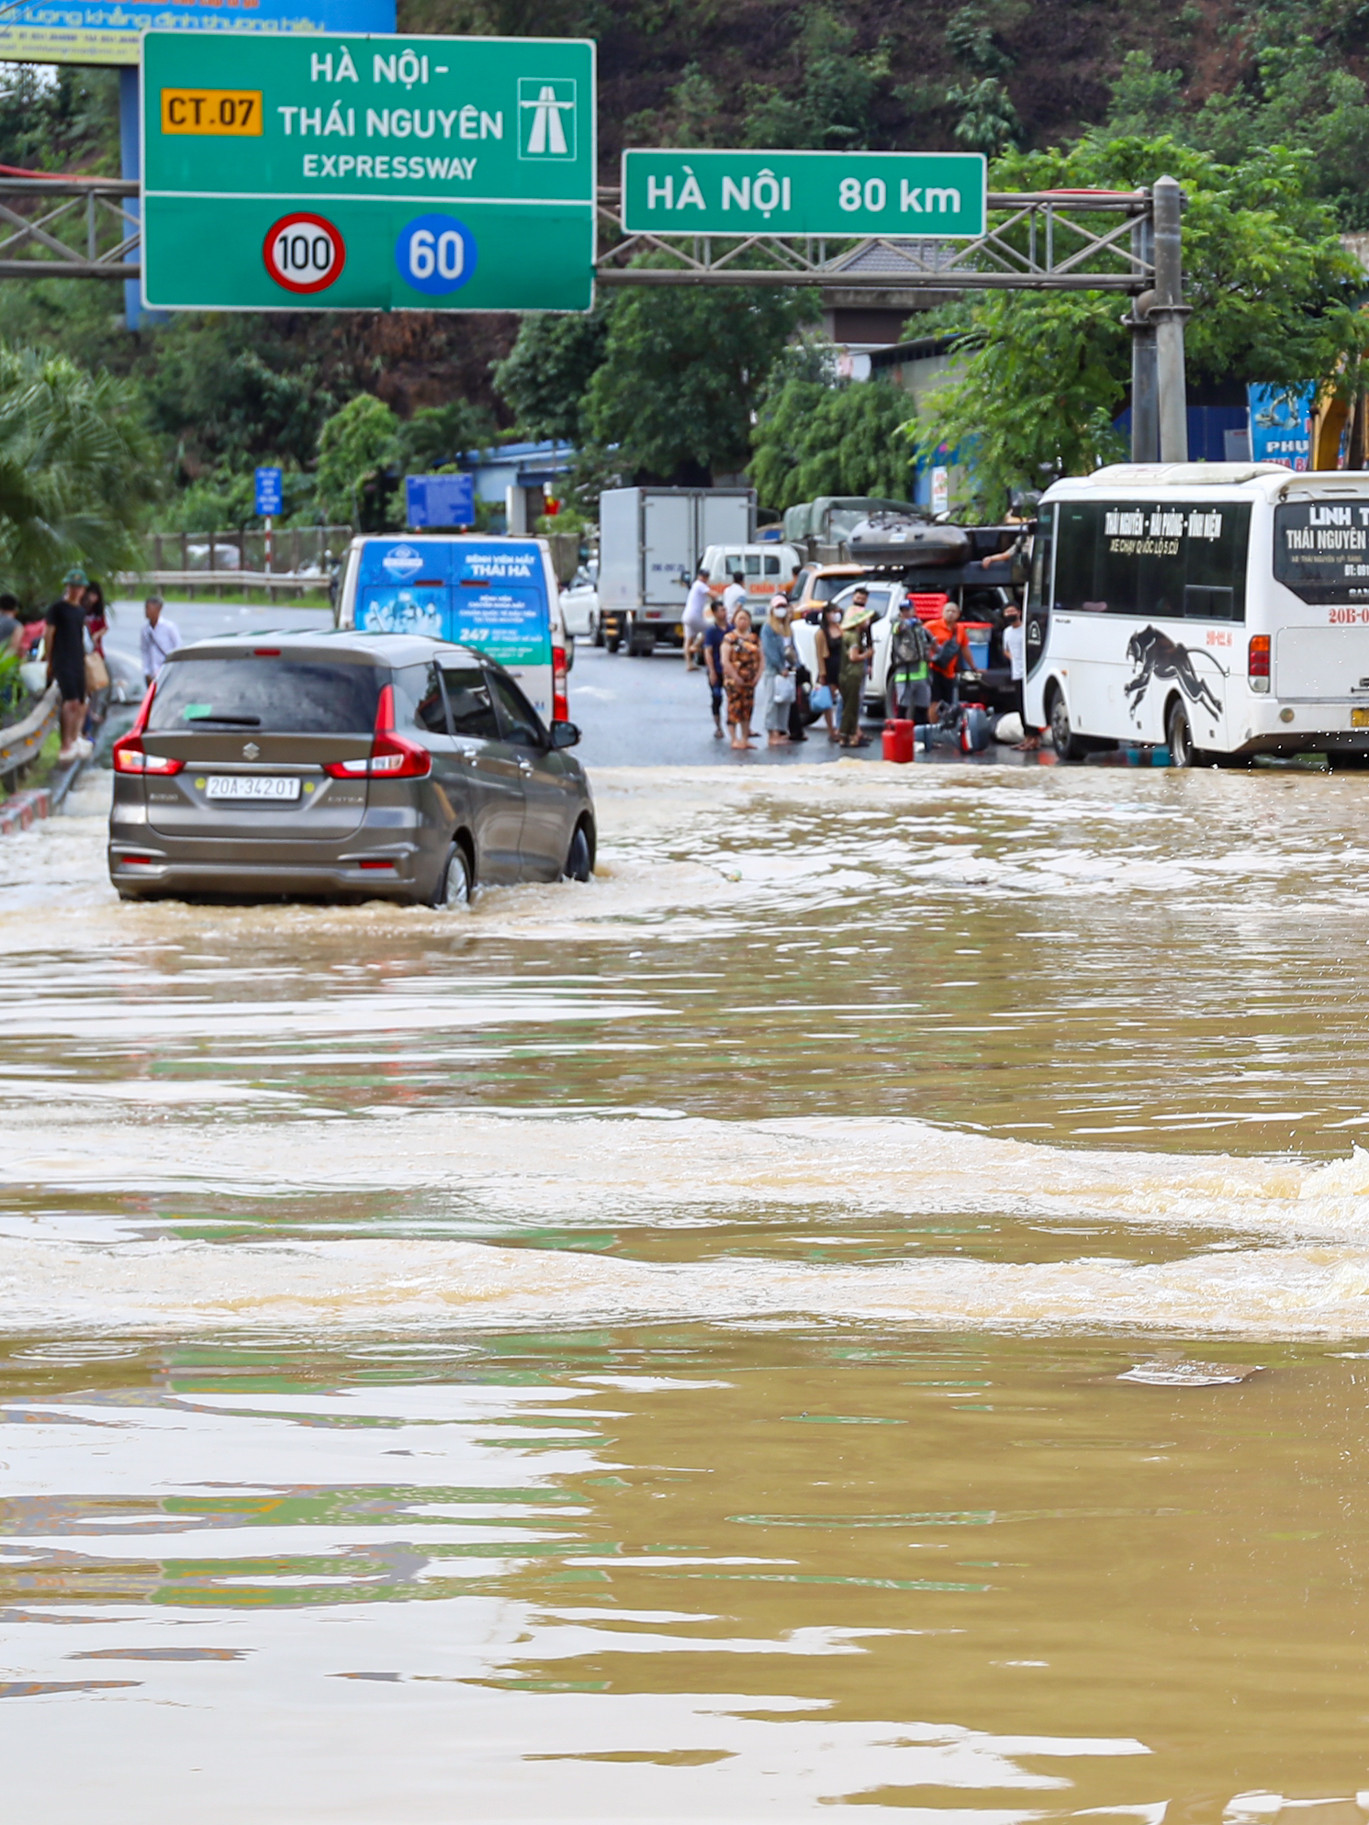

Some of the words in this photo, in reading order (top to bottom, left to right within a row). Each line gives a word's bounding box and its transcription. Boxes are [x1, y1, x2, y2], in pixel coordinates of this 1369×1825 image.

[310, 45, 359, 83] HÀ
[168, 97, 255, 127] CT.07
[277, 98, 356, 137] THÁI
[366, 104, 504, 140] NGUYÊN
[302, 153, 478, 180] EXPRESSWAY
[646, 165, 707, 210] HÀ
[721, 167, 792, 219] NỘI
[838, 177, 888, 213] 80
[900, 178, 961, 213] km
[278, 235, 331, 270] 100
[409, 229, 464, 280] 60
[1309, 507, 1351, 526] LINH
[1286, 526, 1315, 549] THÁI
[1317, 527, 1367, 550] NGUYÊN
[210, 779, 295, 796] 20A-342.01
